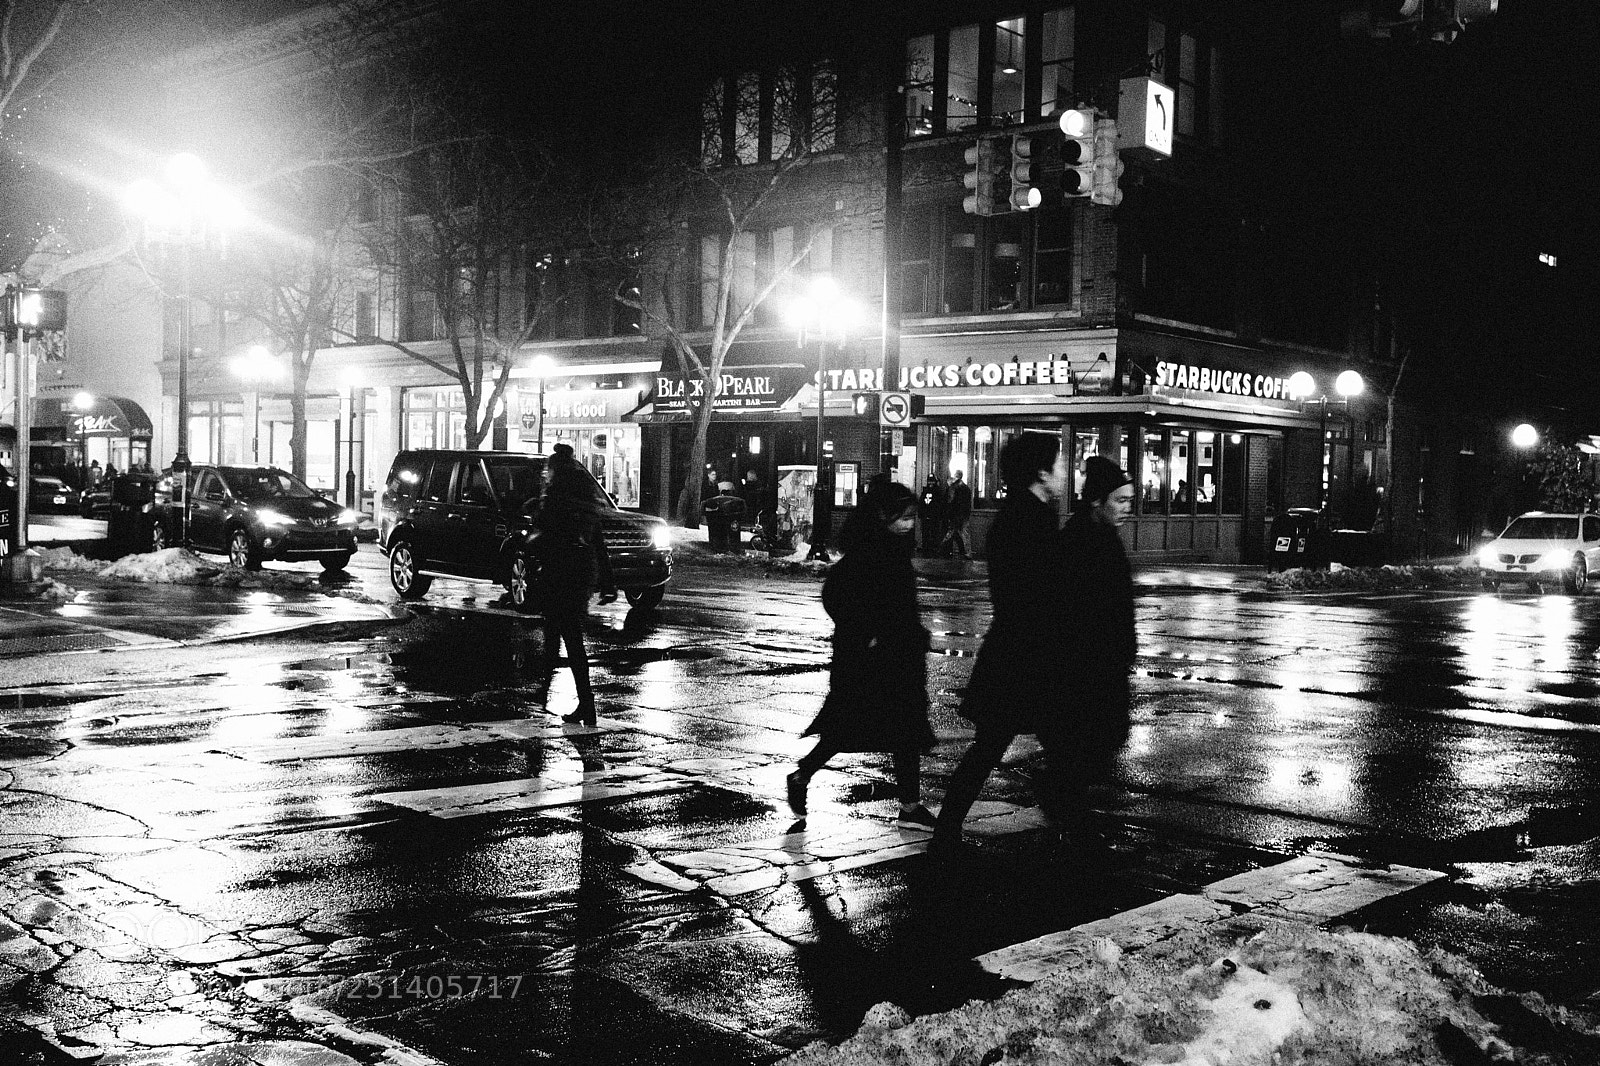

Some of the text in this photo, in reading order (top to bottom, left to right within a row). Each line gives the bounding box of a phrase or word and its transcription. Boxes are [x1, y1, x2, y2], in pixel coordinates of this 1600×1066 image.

[966, 361, 1069, 386] COFFEE
[1156, 361, 1298, 401] STARBUCKS COFF
[721, 374, 775, 396] PEARL
[573, 400, 606, 418] Good
[745, 398, 761, 406] BAR
